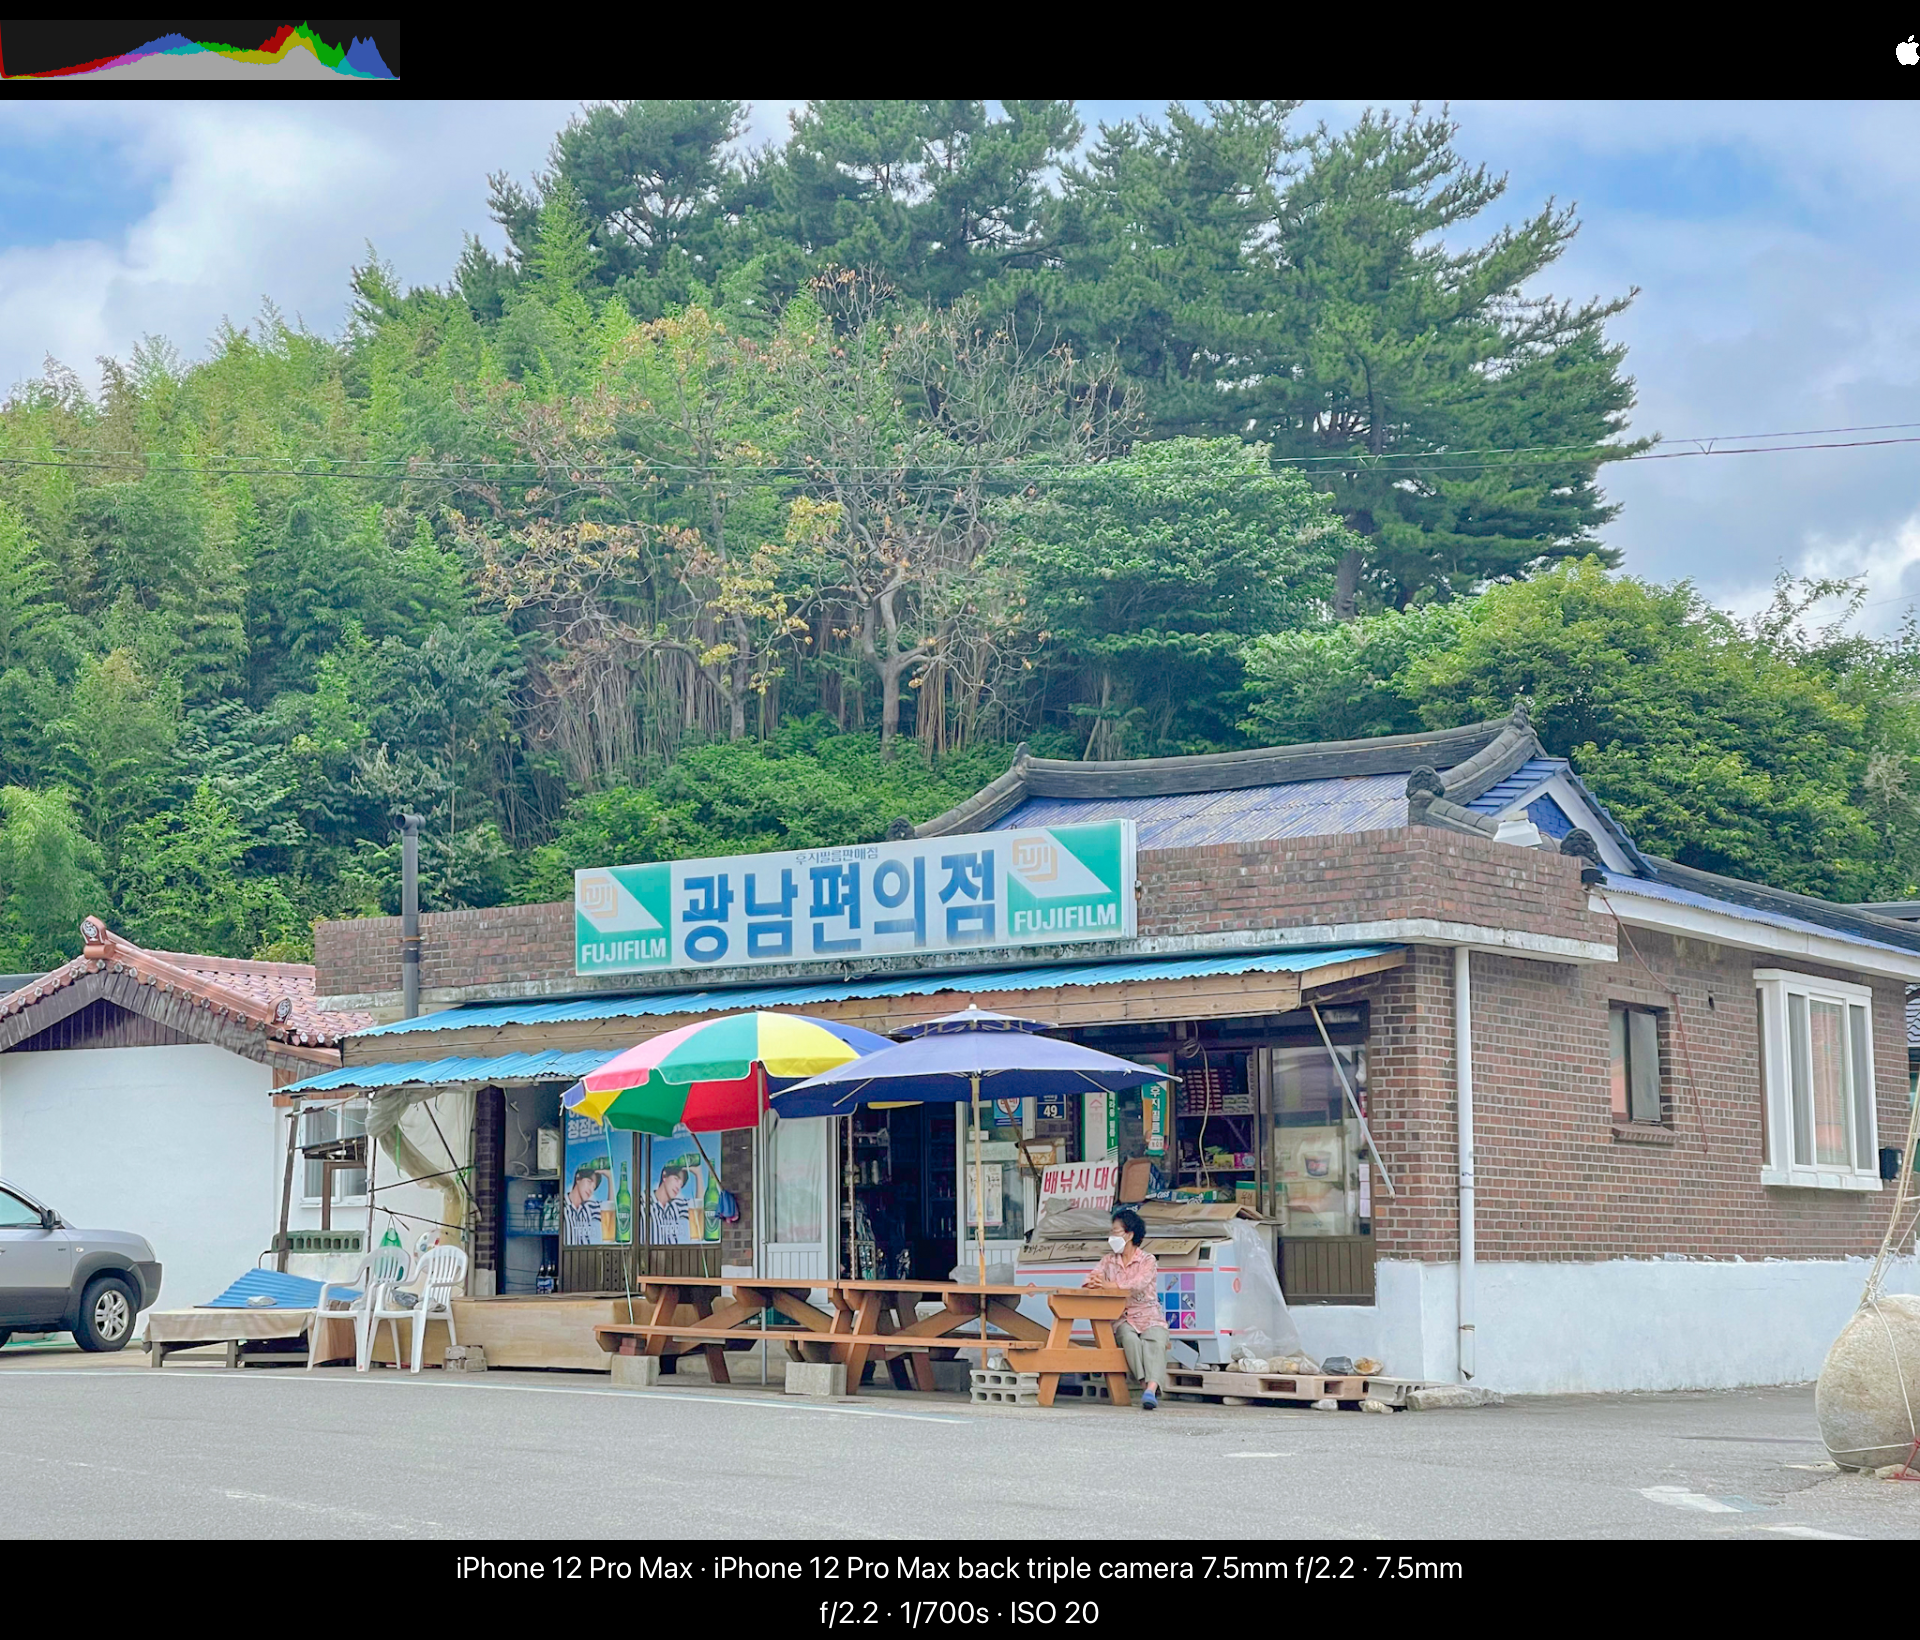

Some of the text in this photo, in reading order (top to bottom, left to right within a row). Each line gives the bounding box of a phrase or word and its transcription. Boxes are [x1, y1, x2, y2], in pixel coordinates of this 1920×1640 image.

[795, 846, 879, 865] 후지필름판매점
[682, 849, 996, 963] 광남편의점
[1014, 903, 1117, 932] FUJIFILM
[581, 937, 667, 964] FUJIFILM
[1043, 1104, 1059, 1117] 49
[1043, 1168, 1090, 1194] 배낚시
